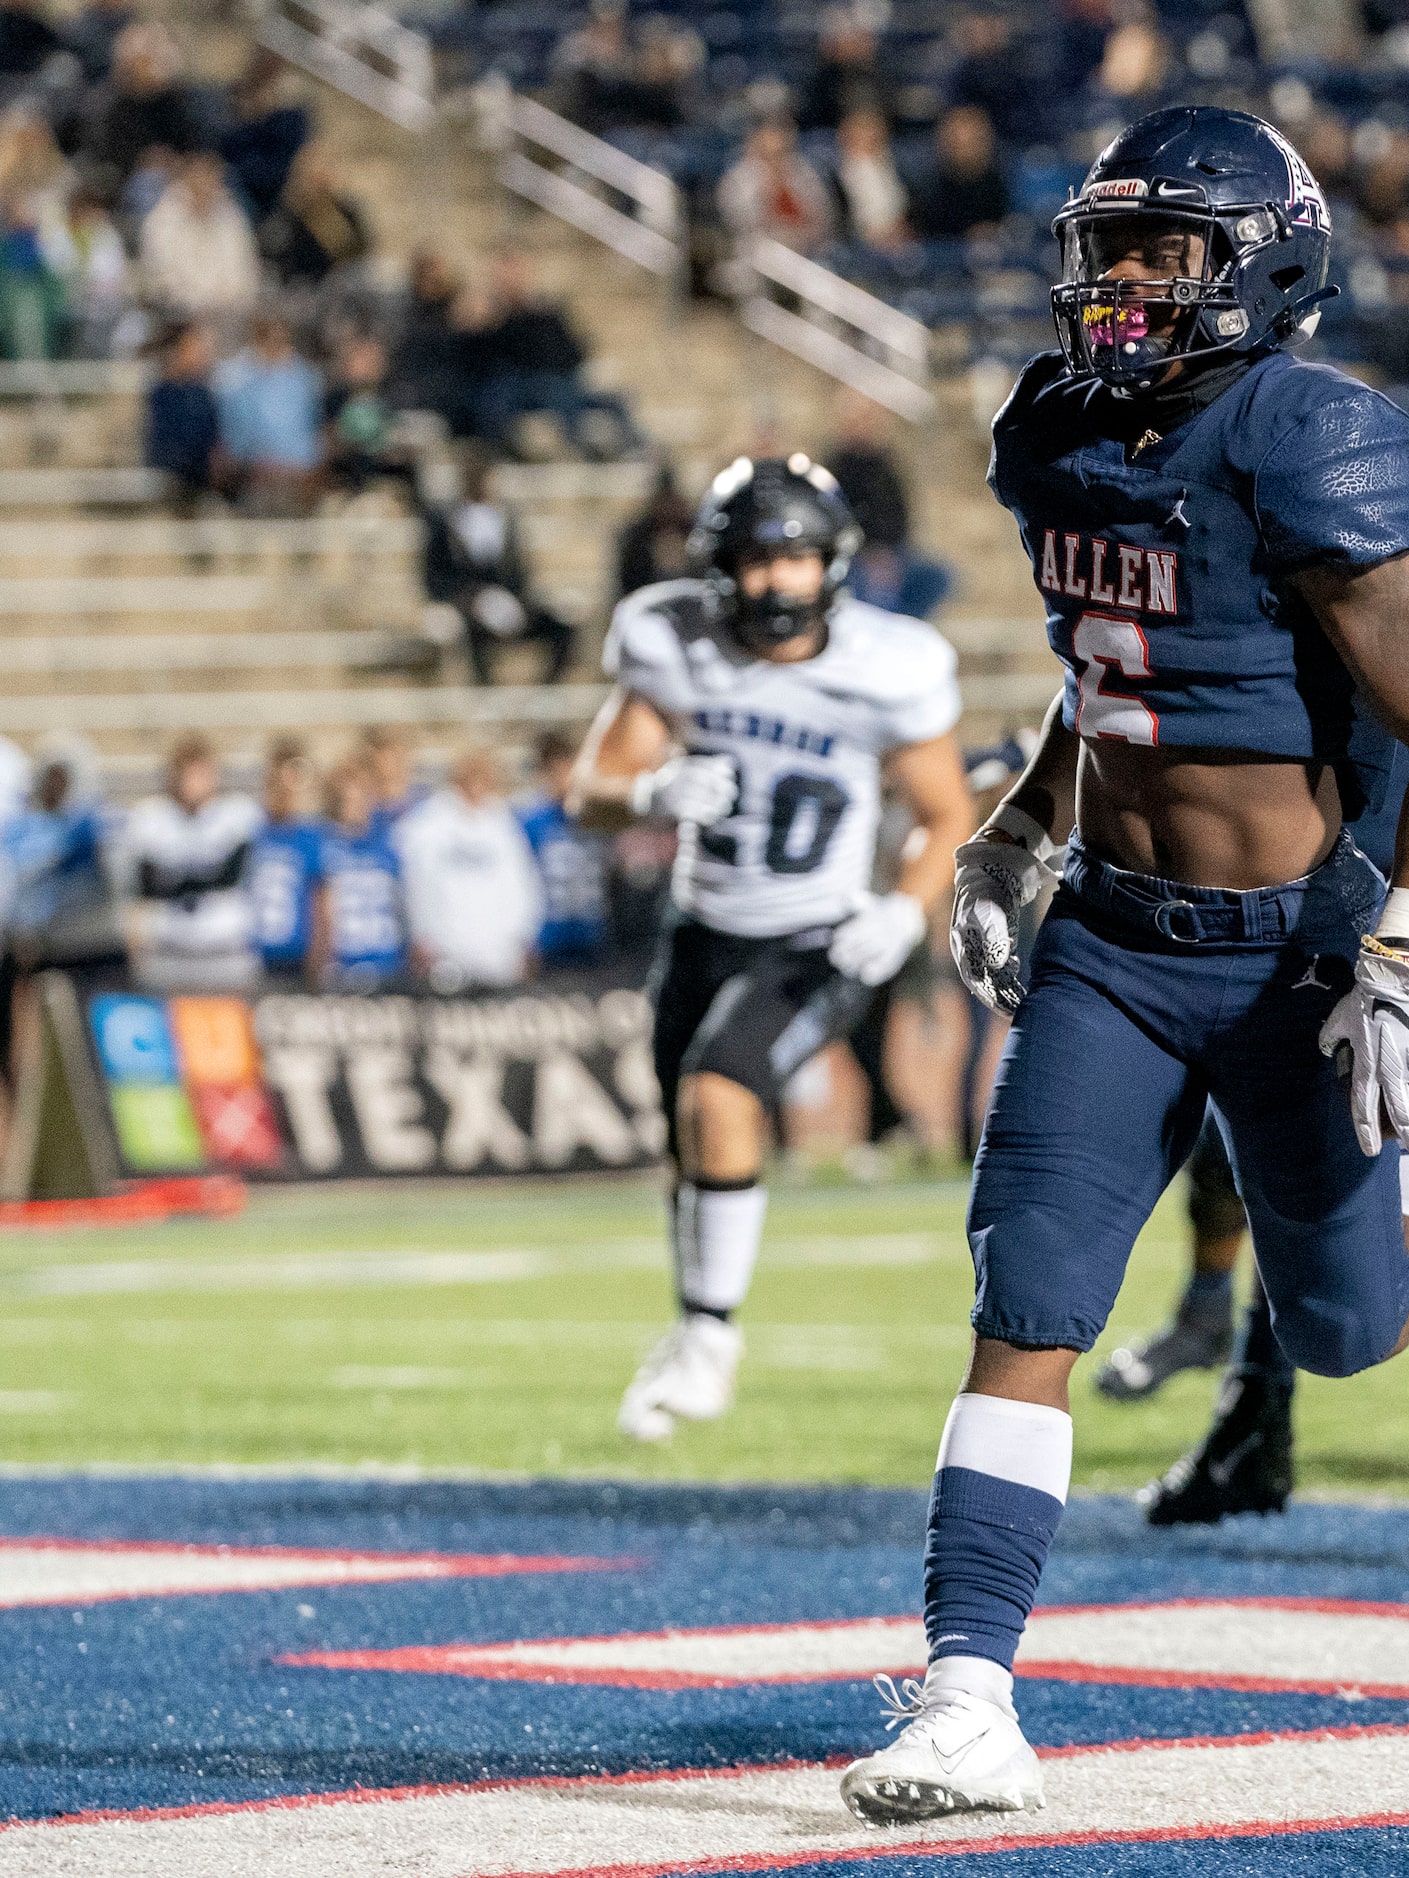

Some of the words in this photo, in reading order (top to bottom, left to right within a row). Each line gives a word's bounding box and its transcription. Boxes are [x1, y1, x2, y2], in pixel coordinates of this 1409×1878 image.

[1083, 306, 1127, 322] BATTE
[1040, 529, 1177, 615] ALLEN
[1072, 611, 1159, 746] 6
